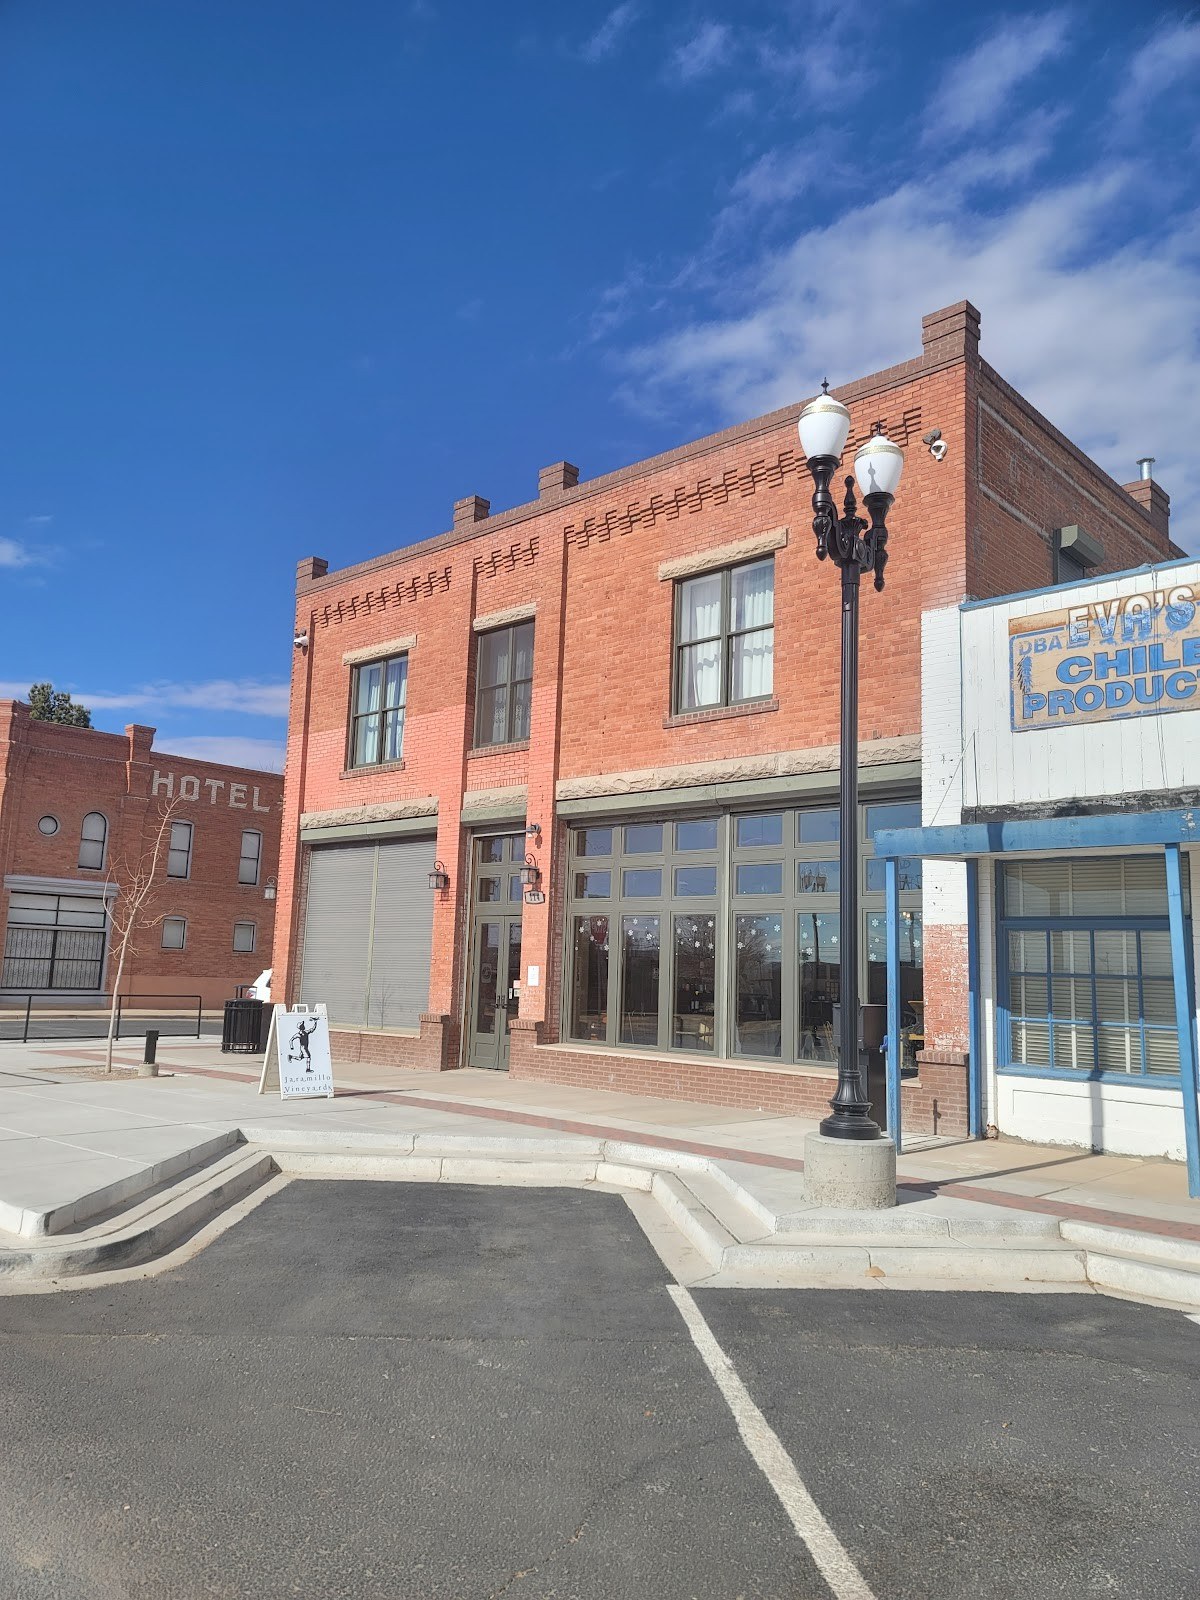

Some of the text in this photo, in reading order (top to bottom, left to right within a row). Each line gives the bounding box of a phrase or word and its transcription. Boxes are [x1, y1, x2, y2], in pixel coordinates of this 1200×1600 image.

[1018, 585, 1196, 656] DBA EVA'S
[1022, 668, 1200, 719] PRODUC
[151, 770, 271, 813] HOTEL
[284, 1074, 331, 1083] Jaramillo
[284, 1084, 332, 1092] Vineyards
